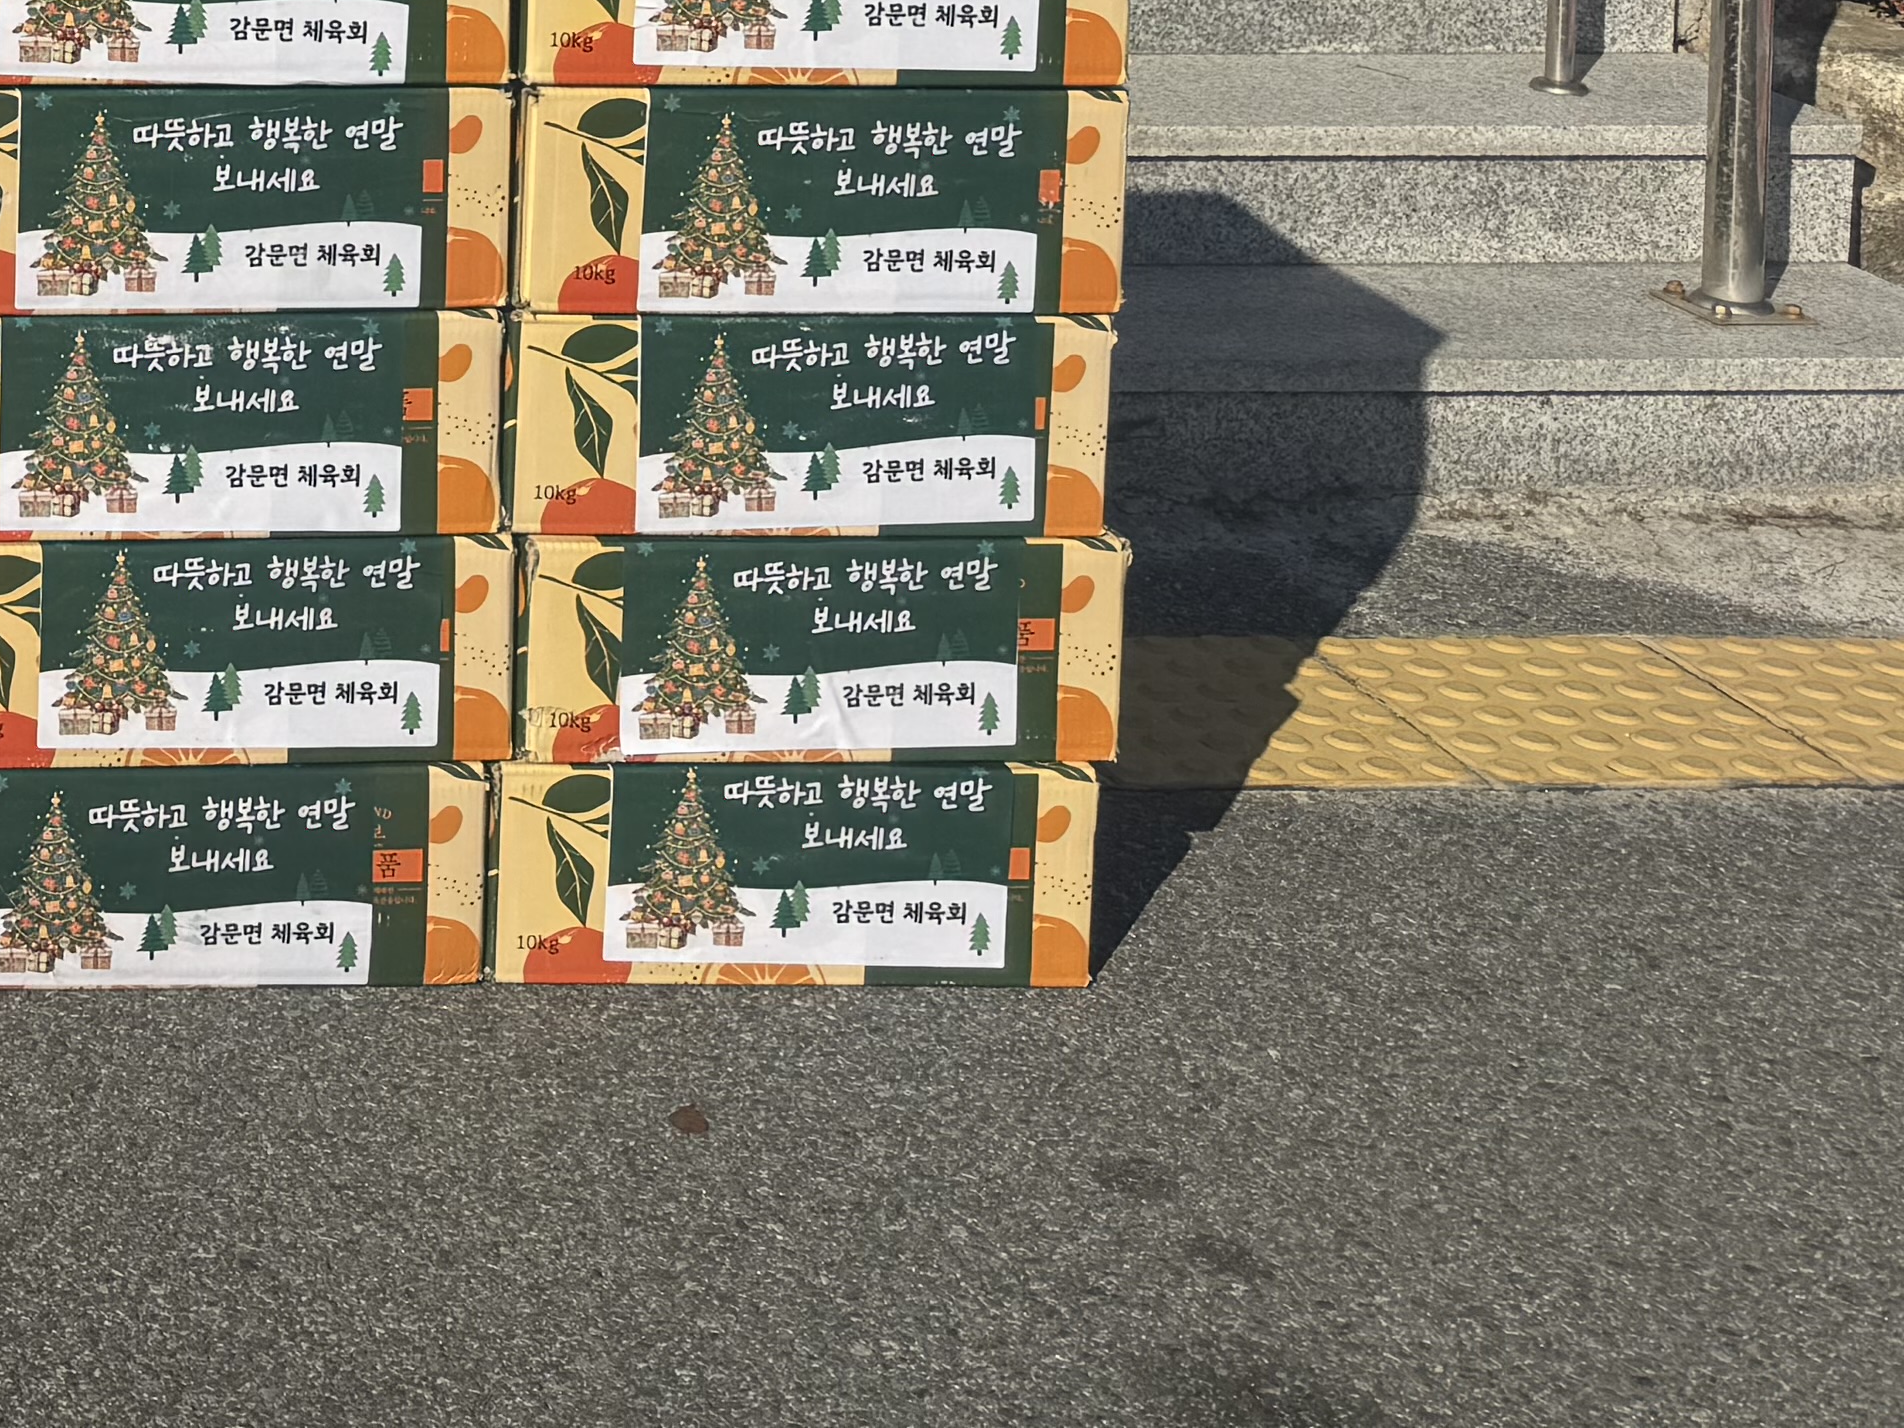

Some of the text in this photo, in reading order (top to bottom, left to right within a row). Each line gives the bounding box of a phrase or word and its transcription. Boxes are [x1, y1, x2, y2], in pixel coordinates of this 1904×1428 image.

[863, 1, 999, 29] 감문면 체육회
[551, 31, 593, 53] 10kg
[131, 115, 405, 155] 따뜻하고 행복한 연말
[211, 163, 322, 194] 보내세요
[244, 242, 381, 268] 감문면 체육회
[573, 263, 616, 284] 10kg
[750, 329, 1017, 373] 따뜻하고 행복한 연말
[828, 382, 937, 411] 보내세요
[862, 455, 996, 485] 감문면 체육회
[152, 554, 421, 593] 따뜻하고 행복한 연말
[230, 602, 340, 632] 보내세요
[263, 680, 399, 707] 감문면 체육회
[722, 774, 993, 814] 따뜻하고 행복한 연말
[800, 821, 909, 852] 보내세요
[831, 899, 967, 926] 감문면 체육회
[516, 934, 559, 956] 10kg
